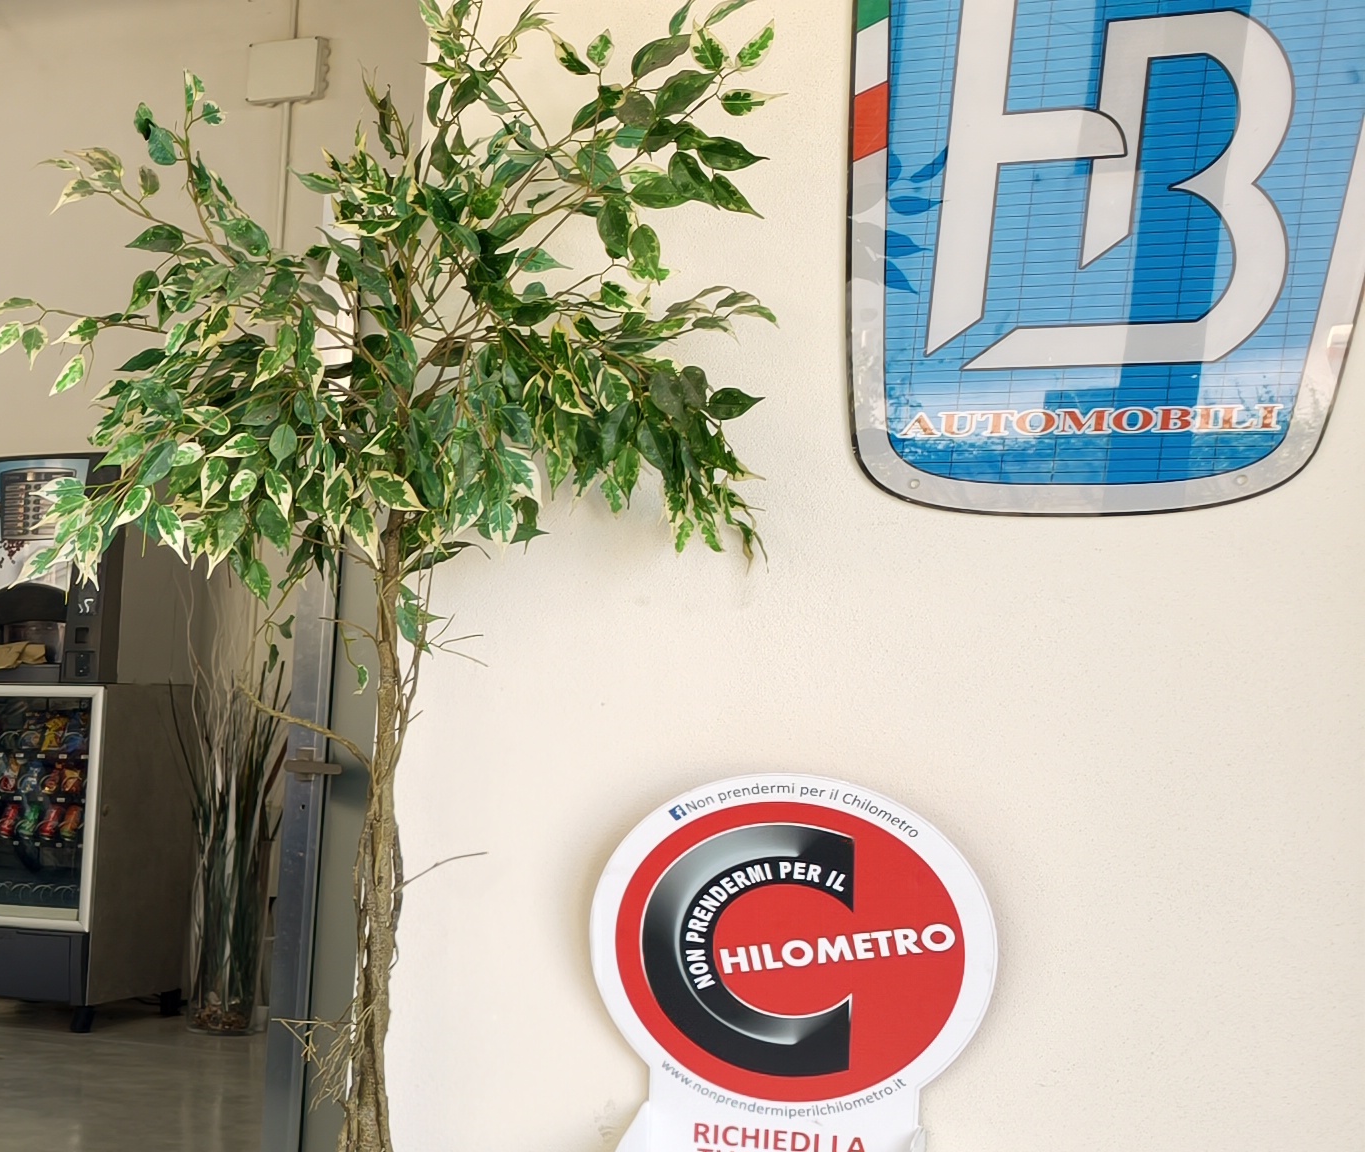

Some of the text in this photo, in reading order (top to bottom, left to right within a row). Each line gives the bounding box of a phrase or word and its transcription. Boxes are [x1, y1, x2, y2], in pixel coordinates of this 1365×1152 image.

[898, 403, 1283, 439] AUTOMOBILI
[686, 783, 919, 839] Non prendermi per il Chilometro
[685, 861, 846, 990] NON PRENDERMI PER IL
[661, 1060, 907, 1119] www.nonprendermiperilchilometro.it
